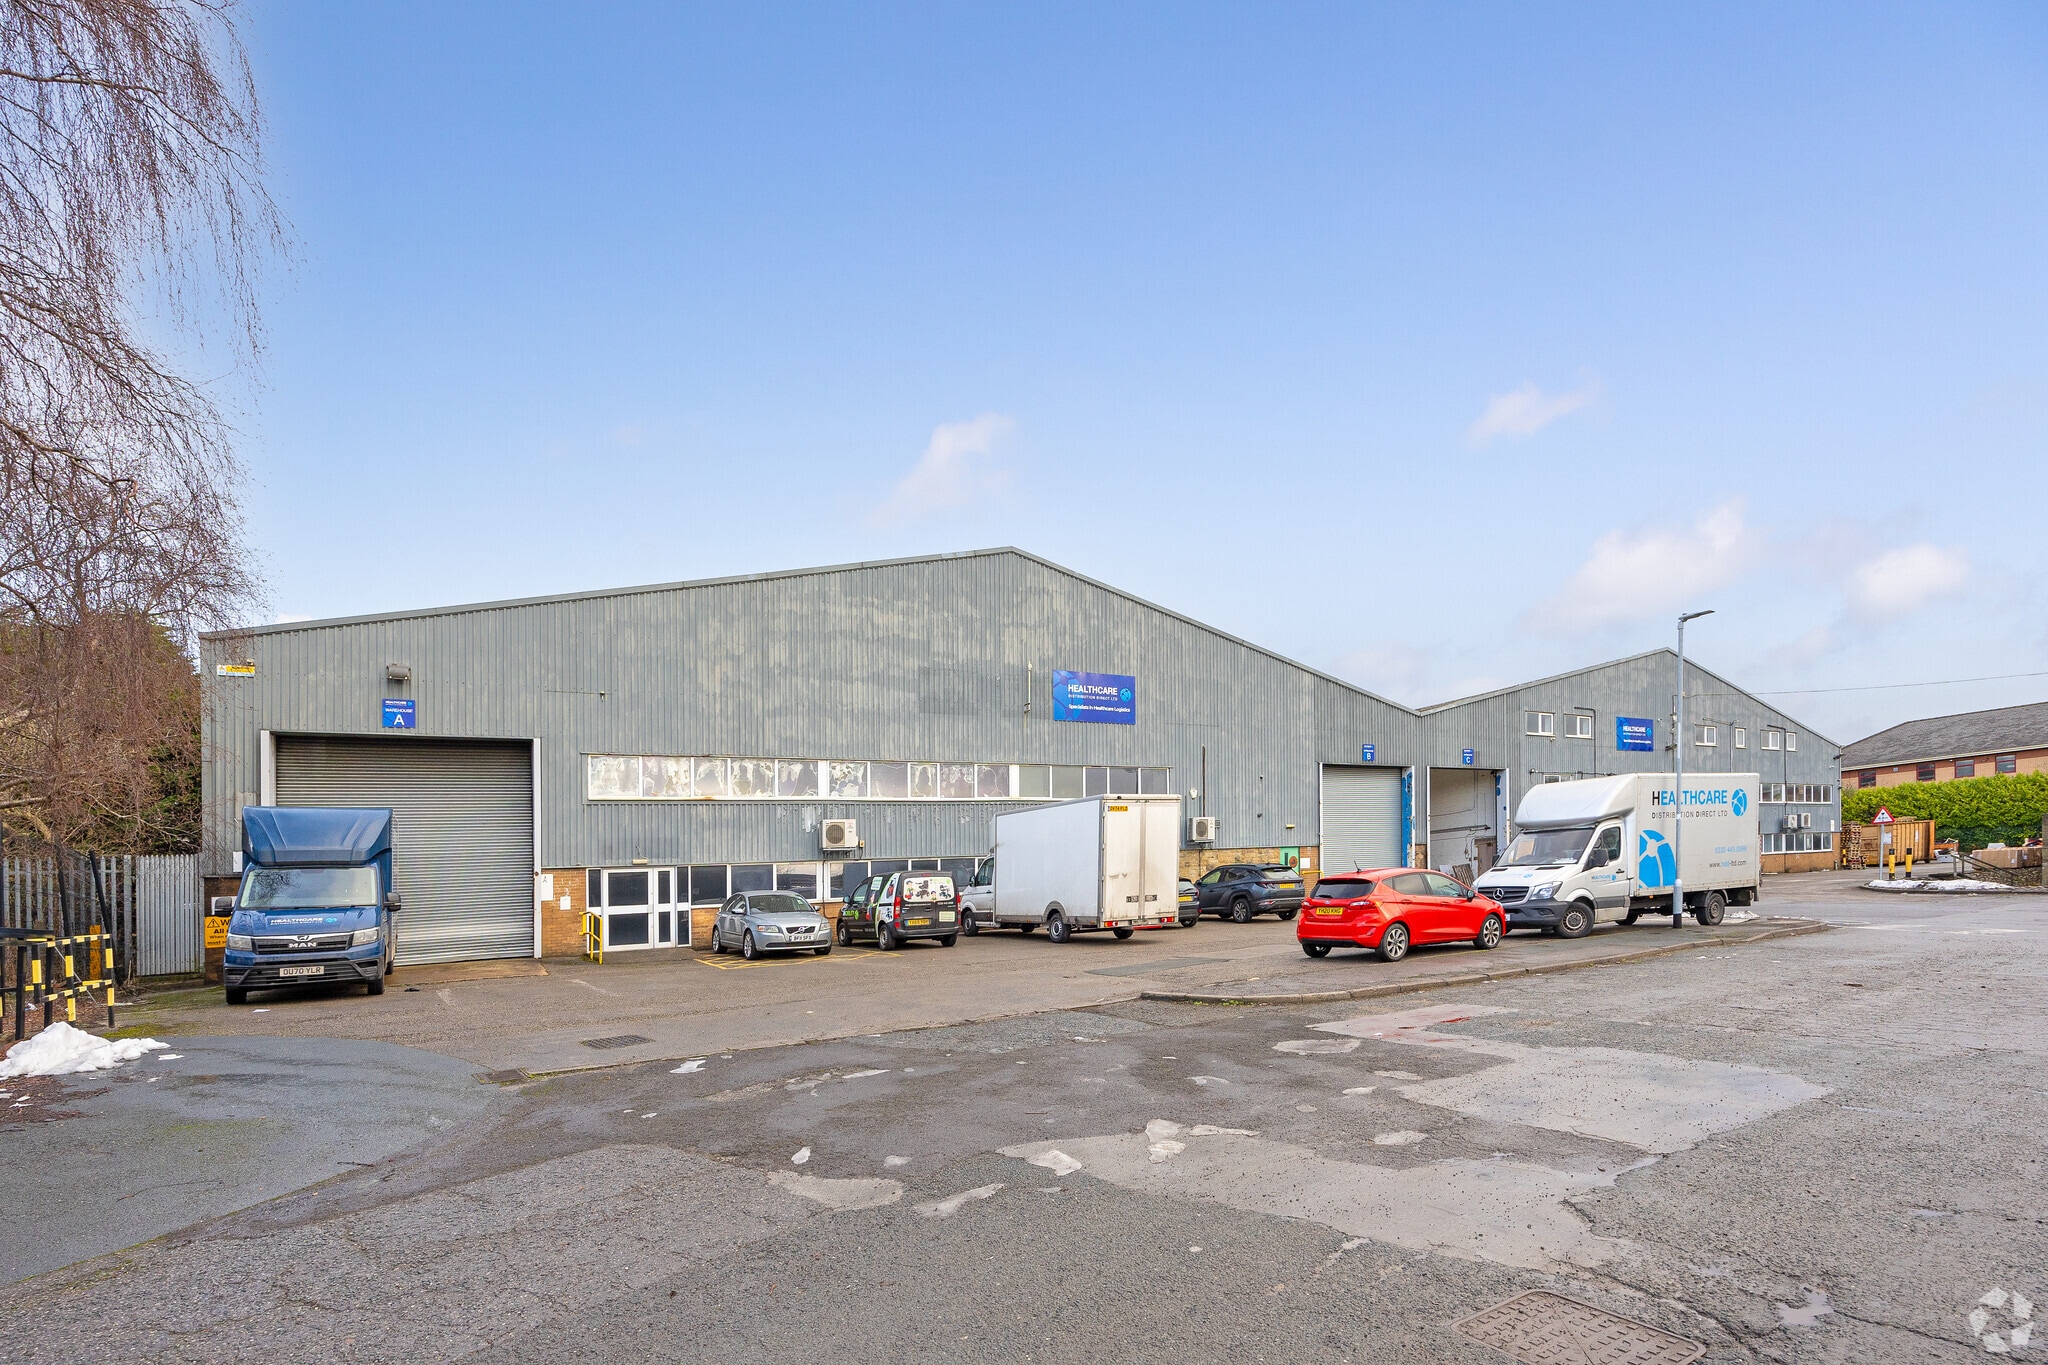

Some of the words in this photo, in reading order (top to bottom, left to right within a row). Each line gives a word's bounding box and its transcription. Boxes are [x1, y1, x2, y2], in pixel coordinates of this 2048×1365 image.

[1068, 684, 1118, 695] HEALTHCARE
[394, 714, 405, 726] A
[1366, 752, 1371, 760] B
[1652, 811, 1694, 819] DISTRIBTION
[305, 966, 321, 974] YLR
